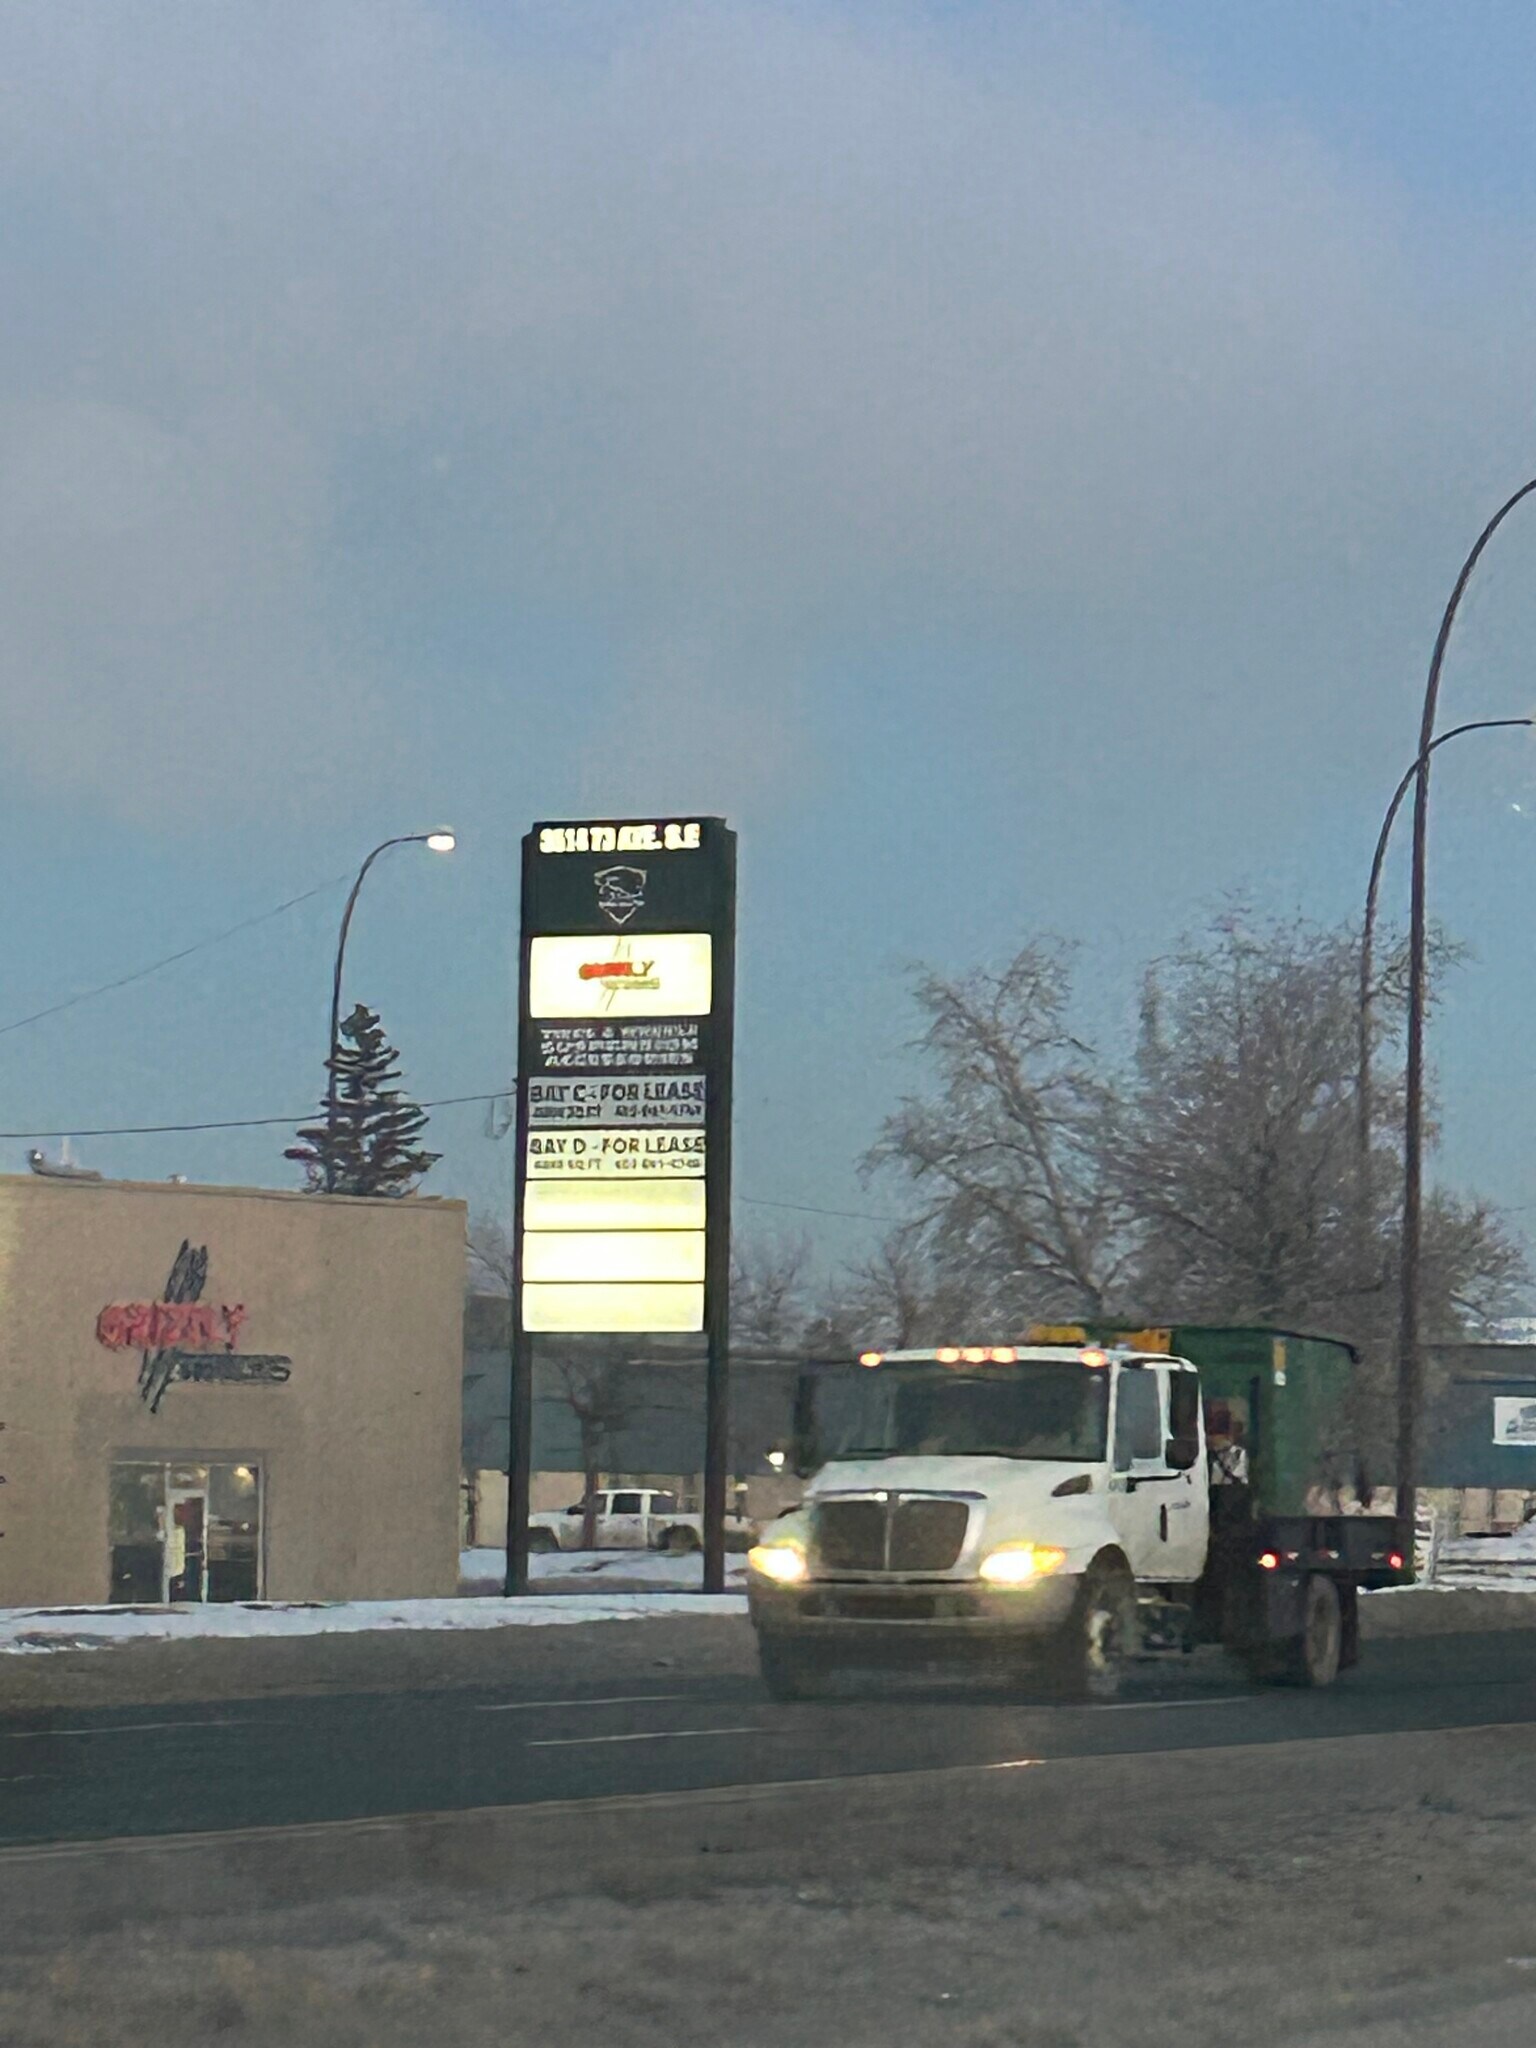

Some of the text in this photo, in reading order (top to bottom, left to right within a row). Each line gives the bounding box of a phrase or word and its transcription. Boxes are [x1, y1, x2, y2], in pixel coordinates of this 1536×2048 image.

[573, 1138, 586, 1154] D
[601, 1137, 639, 1154] FOR
[645, 1136, 706, 1153] LEASE
